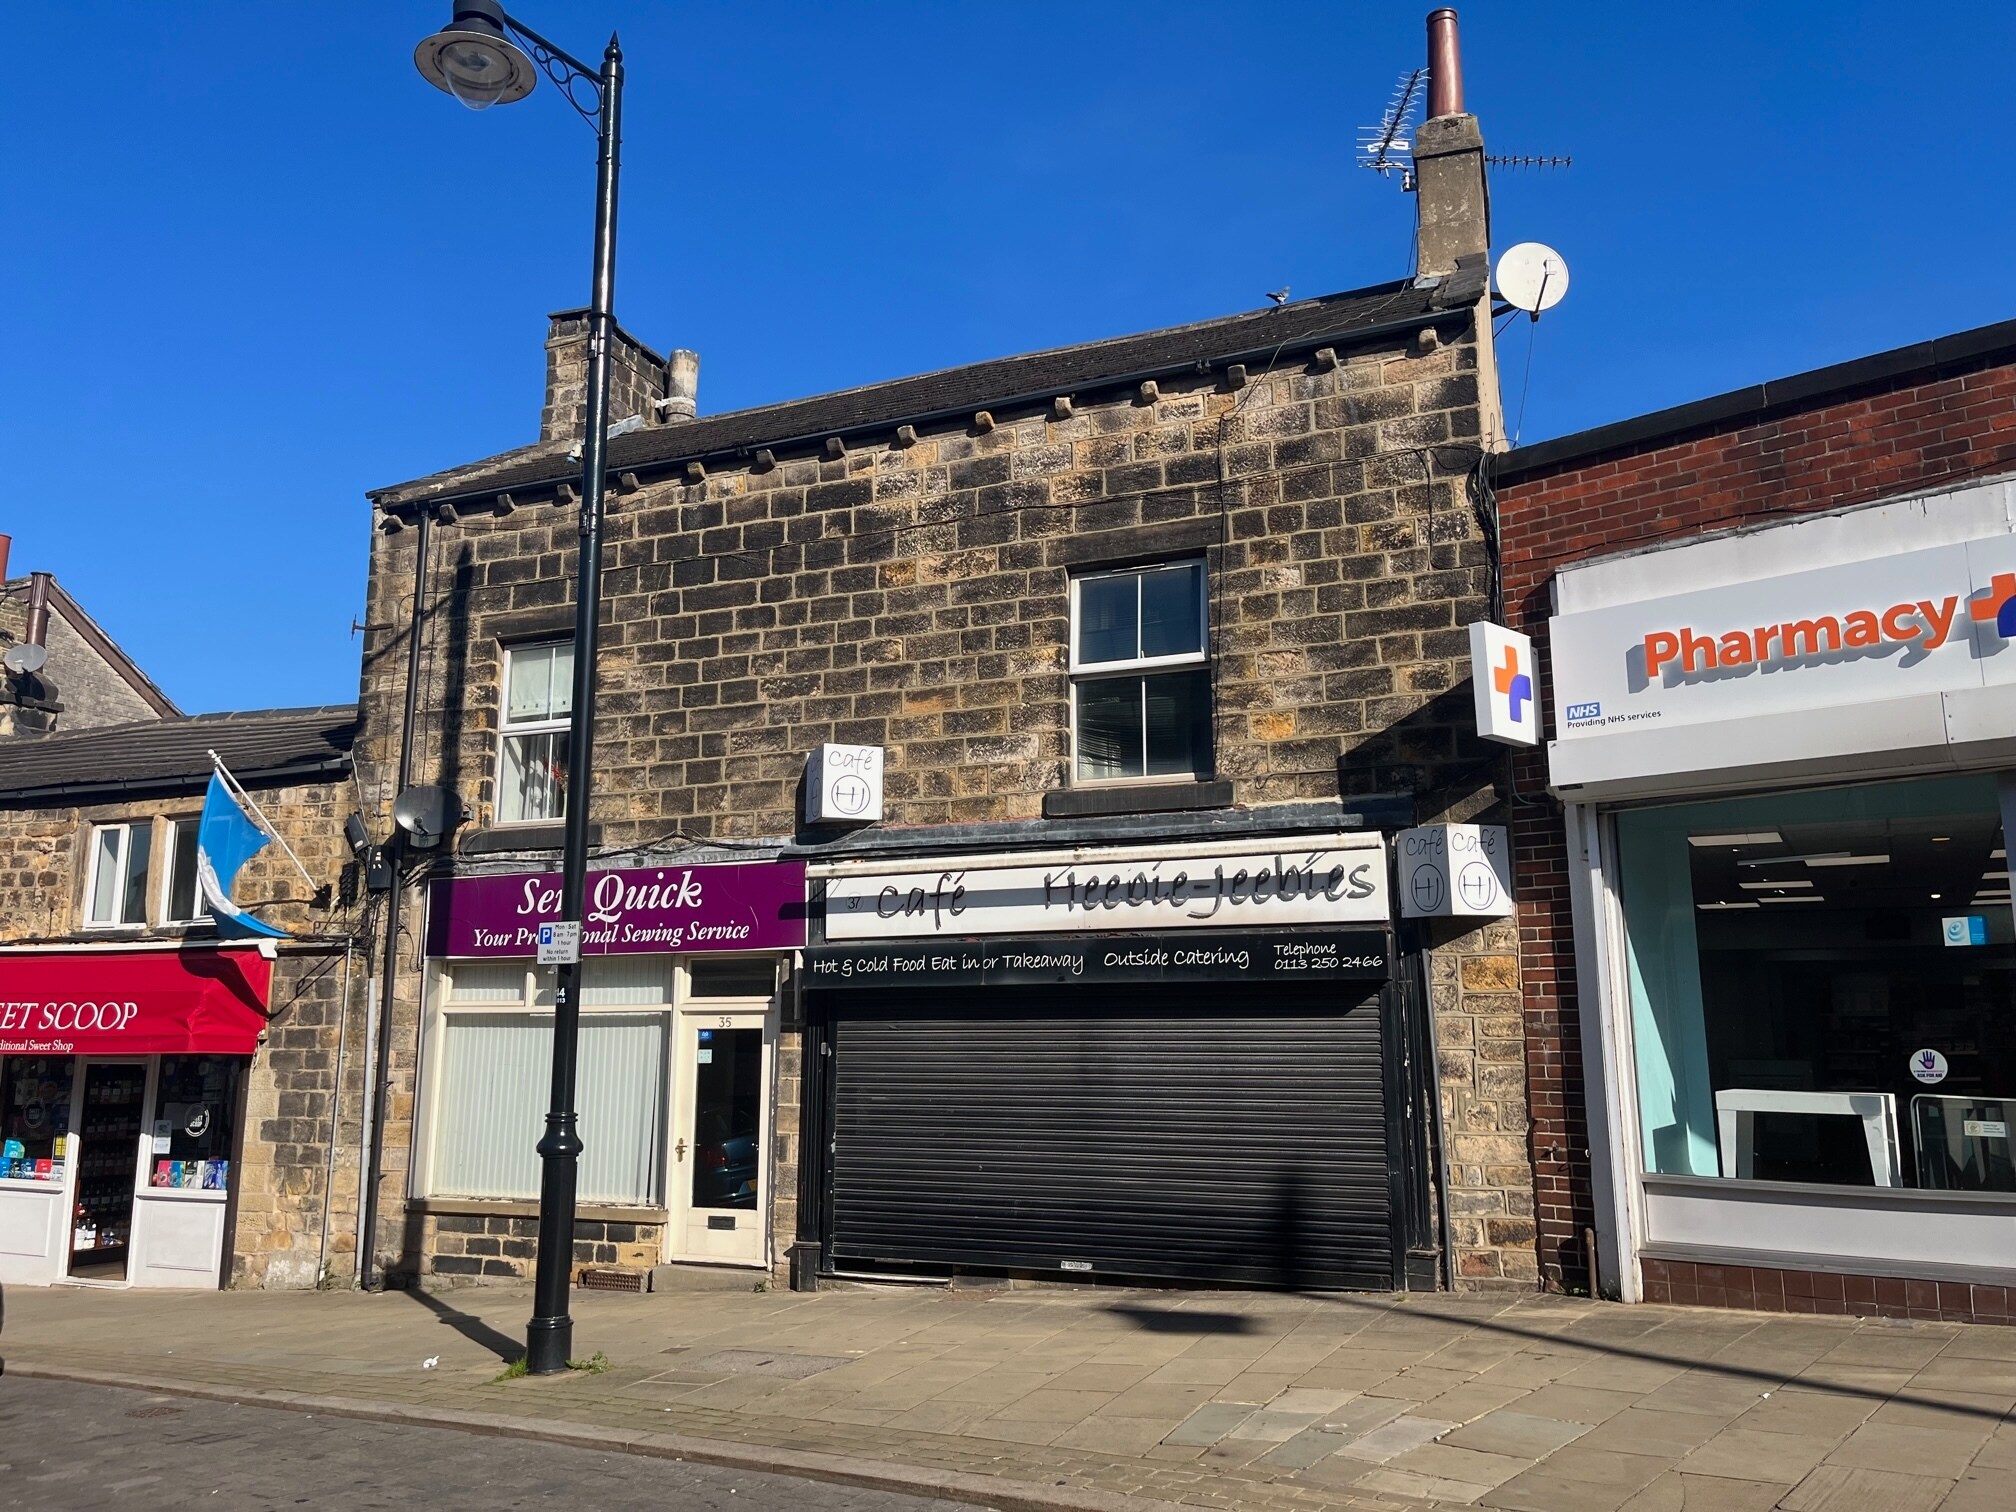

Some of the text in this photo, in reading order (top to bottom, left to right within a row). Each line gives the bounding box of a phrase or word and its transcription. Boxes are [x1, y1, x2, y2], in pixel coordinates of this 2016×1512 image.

[1643, 594, 1960, 679] Pharmacy
[1567, 710, 1662, 729] Providing NHS services
[1568, 703, 1598, 719] NHS
[587, 869, 703, 923] Quick
[847, 896, 862, 910] 37
[473, 928, 513, 948] Your
[621, 923, 684, 948] Sewing
[687, 920, 751, 940] Service
[542, 928, 551, 943] P
[1273, 942, 1337, 956] Telephone
[812, 952, 1084, 976] Hot & Cold Food Eat in or Takeaway
[1103, 947, 1250, 969] Outside Catering
[1274, 955, 1383, 970] 0113 250 2466
[38, 1001, 138, 1030] SCOOP
[718, 1016, 732, 1028] 35
[28, 1039, 52, 1051] Sweet
[52, 1039, 74, 1053] Shop
